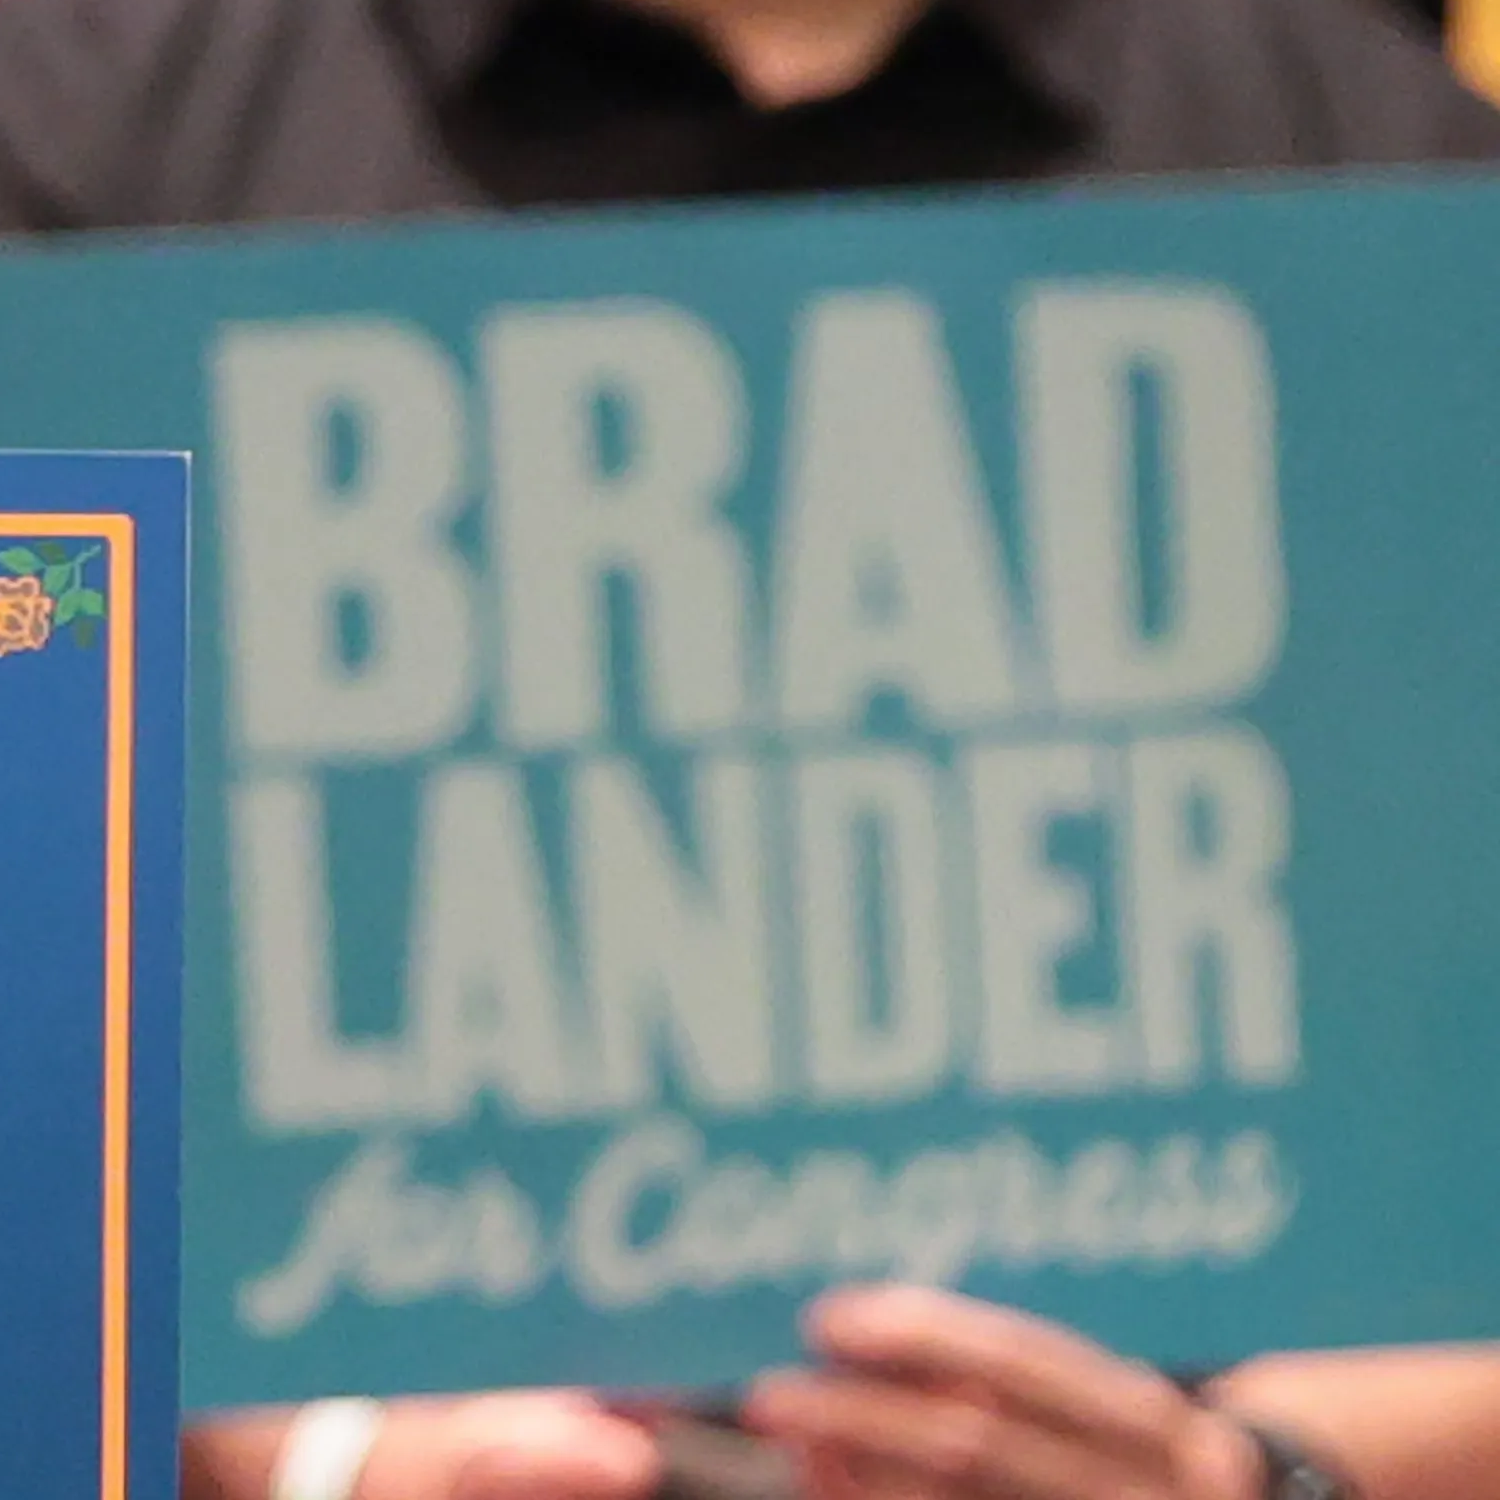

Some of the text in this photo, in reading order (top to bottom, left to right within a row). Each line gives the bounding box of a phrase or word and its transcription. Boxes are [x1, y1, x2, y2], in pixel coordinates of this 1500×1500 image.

[210, 276, 1286, 758] BRAD
[227, 722, 1303, 1132] LANDER
[235, 1112, 1295, 1338] for Congress
